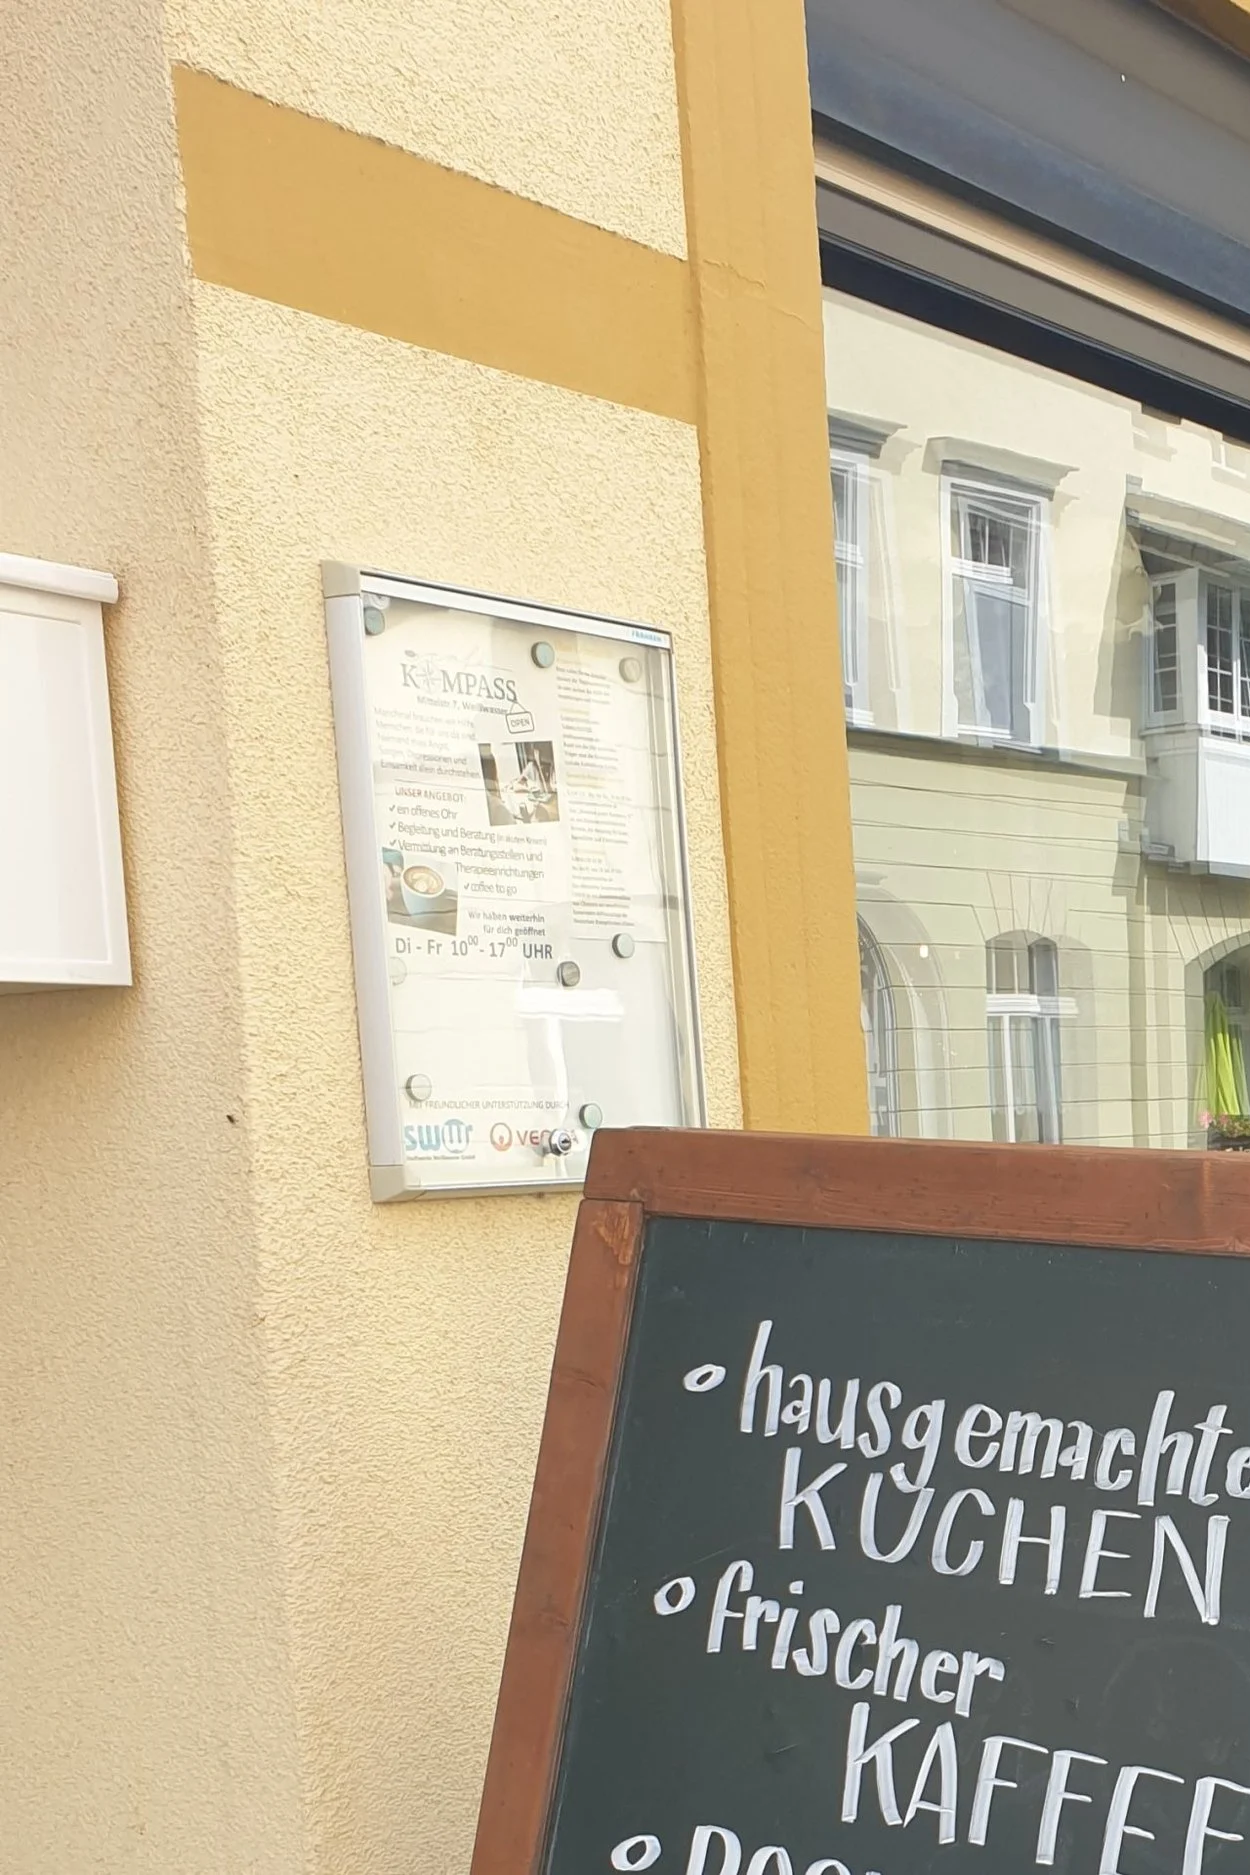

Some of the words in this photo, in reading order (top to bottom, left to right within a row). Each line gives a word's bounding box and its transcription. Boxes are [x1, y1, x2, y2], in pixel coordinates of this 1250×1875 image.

[510, 717, 531, 728] OPEN
[395, 786, 422, 798] UNSER
[397, 805, 410, 815] ein
[411, 804, 440, 819] offenes
[440, 808, 458, 820] Ohr
[398, 821, 440, 839] Begleitung
[441, 826, 459, 838] und
[460, 827, 496, 845] Beratung
[398, 839, 447, 857] Vermittlung
[447, 845, 459, 854] an
[526, 850, 543, 862] und
[471, 880, 494, 893] coffee
[495, 882, 505, 894] to
[506, 885, 518, 896] go
[467, 909, 481, 920] Wir
[482, 910, 507, 921] haben
[508, 912, 545, 924] weiterhin
[483, 924, 495, 935] für
[496, 924, 513, 936] dich
[513, 925, 546, 938] geöffnet
[395, 936, 412, 955] Di
[427, 937, 443, 956] Fr
[522, 942, 553, 960] UHR
[778, 1446, 1231, 1626] KUCHEN
[706, 1559, 1006, 1717] frischer
